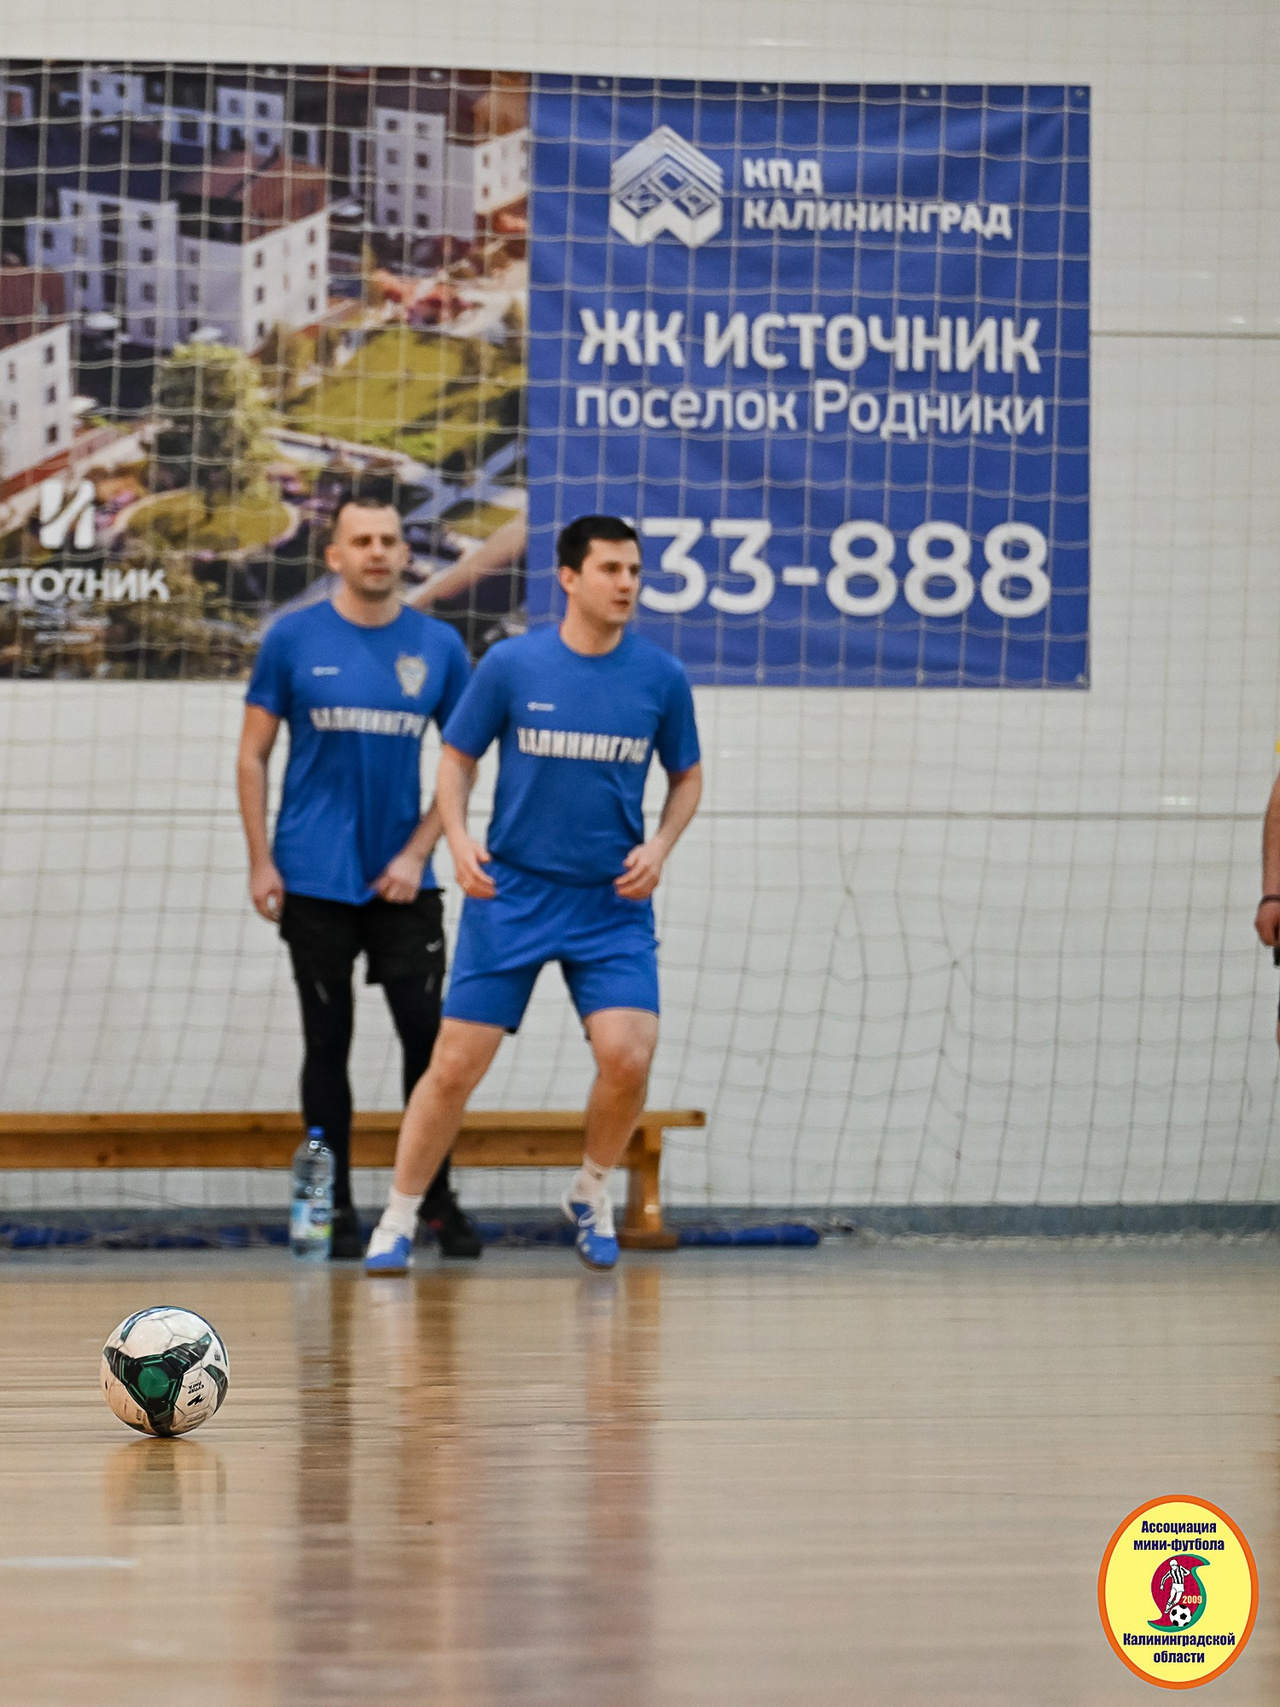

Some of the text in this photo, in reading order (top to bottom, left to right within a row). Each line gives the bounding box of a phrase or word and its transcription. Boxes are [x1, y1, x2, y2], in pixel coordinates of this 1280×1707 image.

[743, 159, 821, 193] КПД
[743, 199, 1012, 239] КАЛИНИНГРАД
[578, 309, 1041, 373] ЖК ИСТОЧНИК
[576, 380, 1044, 440] поселок Родники
[623, 517, 1052, 617] 33-888
